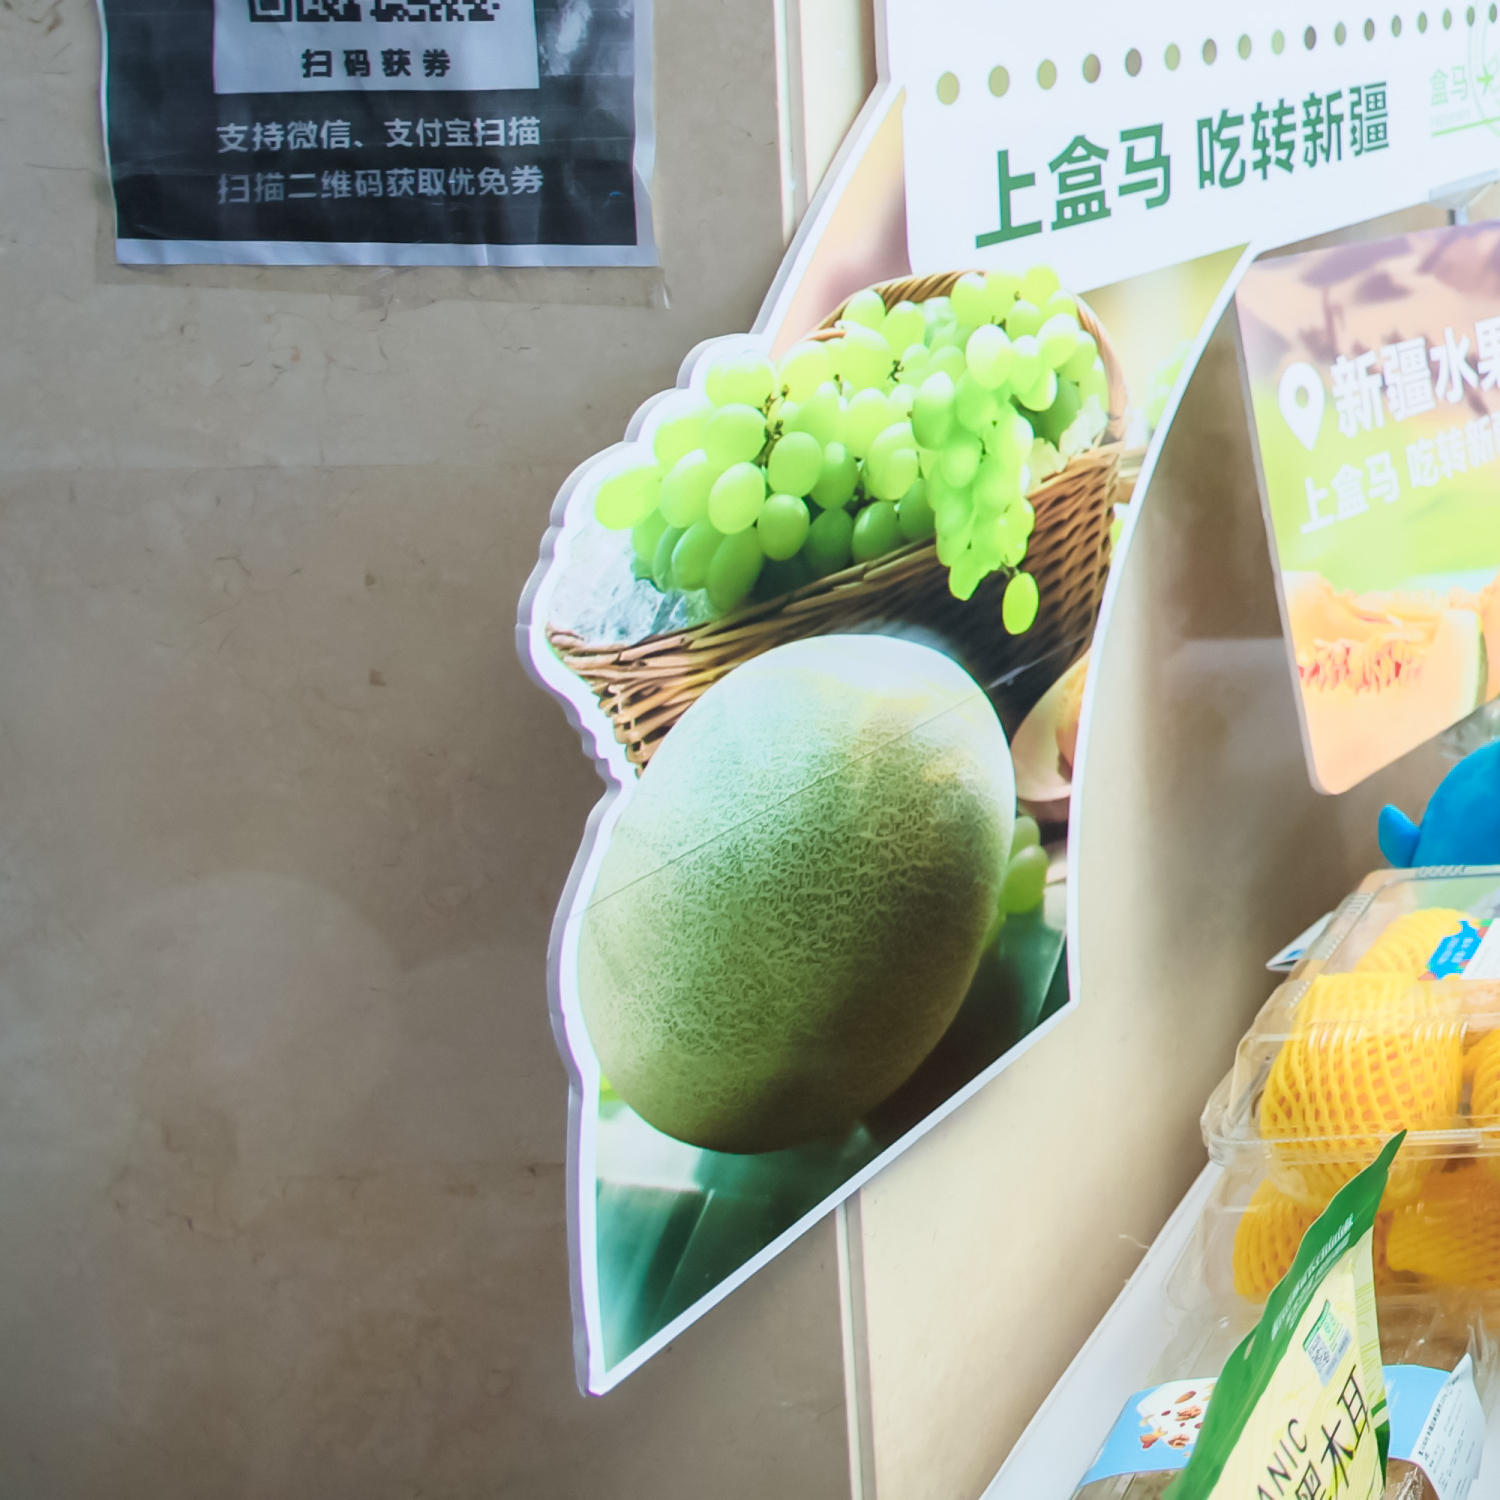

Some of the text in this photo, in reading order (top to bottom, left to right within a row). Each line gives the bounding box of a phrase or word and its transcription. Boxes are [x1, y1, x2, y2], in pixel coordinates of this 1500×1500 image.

[302, 49, 450, 78] 扫码获券
[1430, 65, 1468, 106] 盒马
[216, 116, 541, 153] 支持微信、支付宝扫描
[217, 165, 544, 204] 扫描二维码获取优免券
[975, 81, 1390, 250] 上盒马 吃转新疆
[1300, 451, 1399, 534] 上盒马
